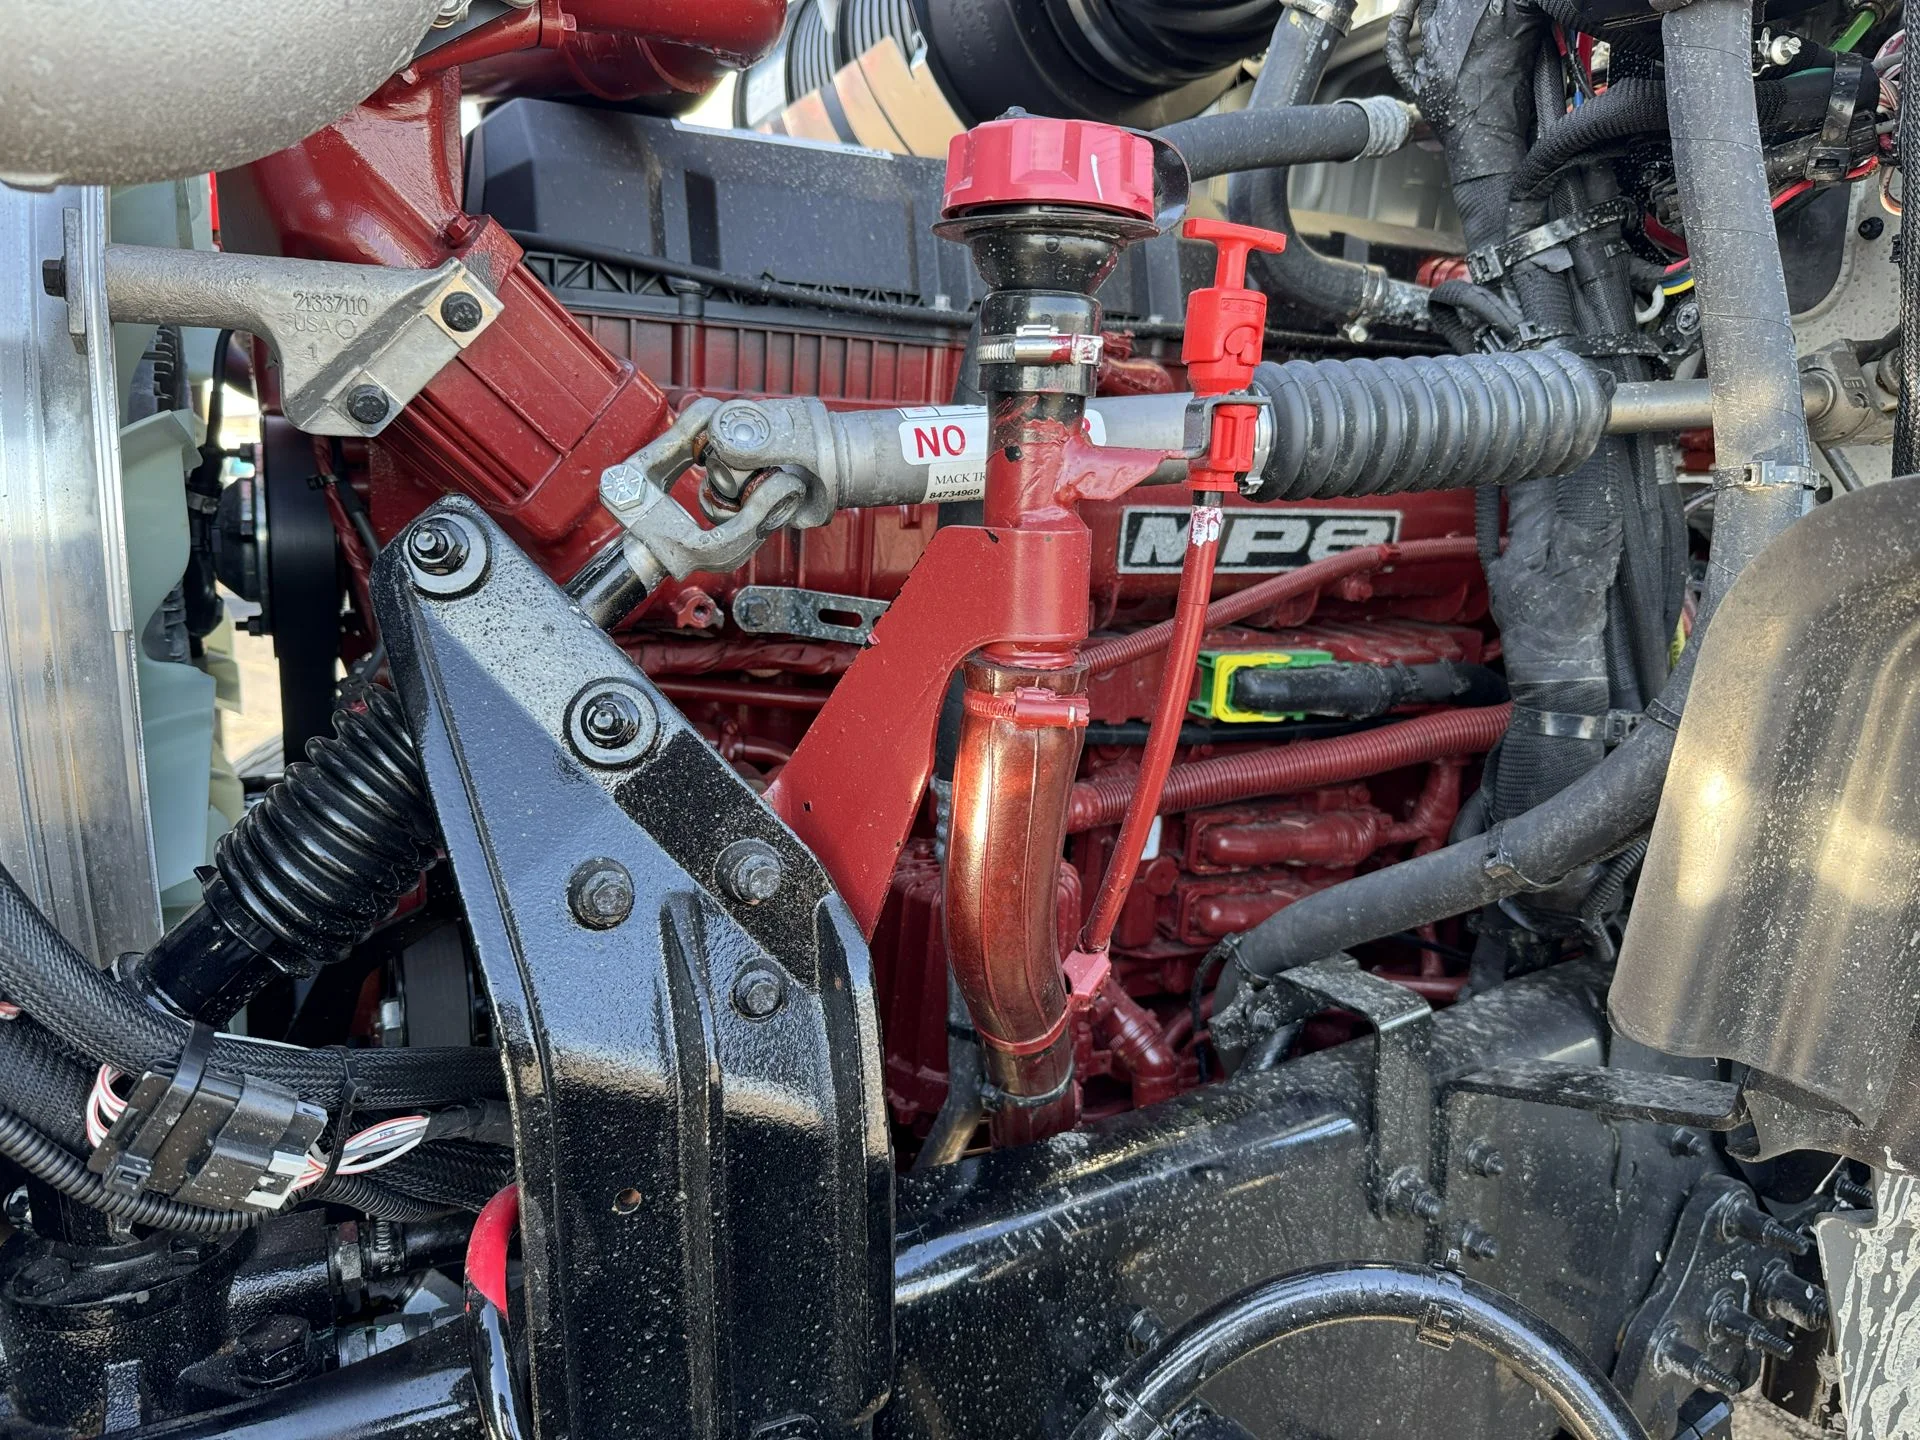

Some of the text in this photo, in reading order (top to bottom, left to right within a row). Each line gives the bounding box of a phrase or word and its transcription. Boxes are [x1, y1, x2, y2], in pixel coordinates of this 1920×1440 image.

[292, 290, 369, 317] 21337110
[293, 317, 332, 333] USA
[913, 424, 967, 459] NO
[934, 472, 971, 485] MACK
[928, 488, 981, 499] 84734969
